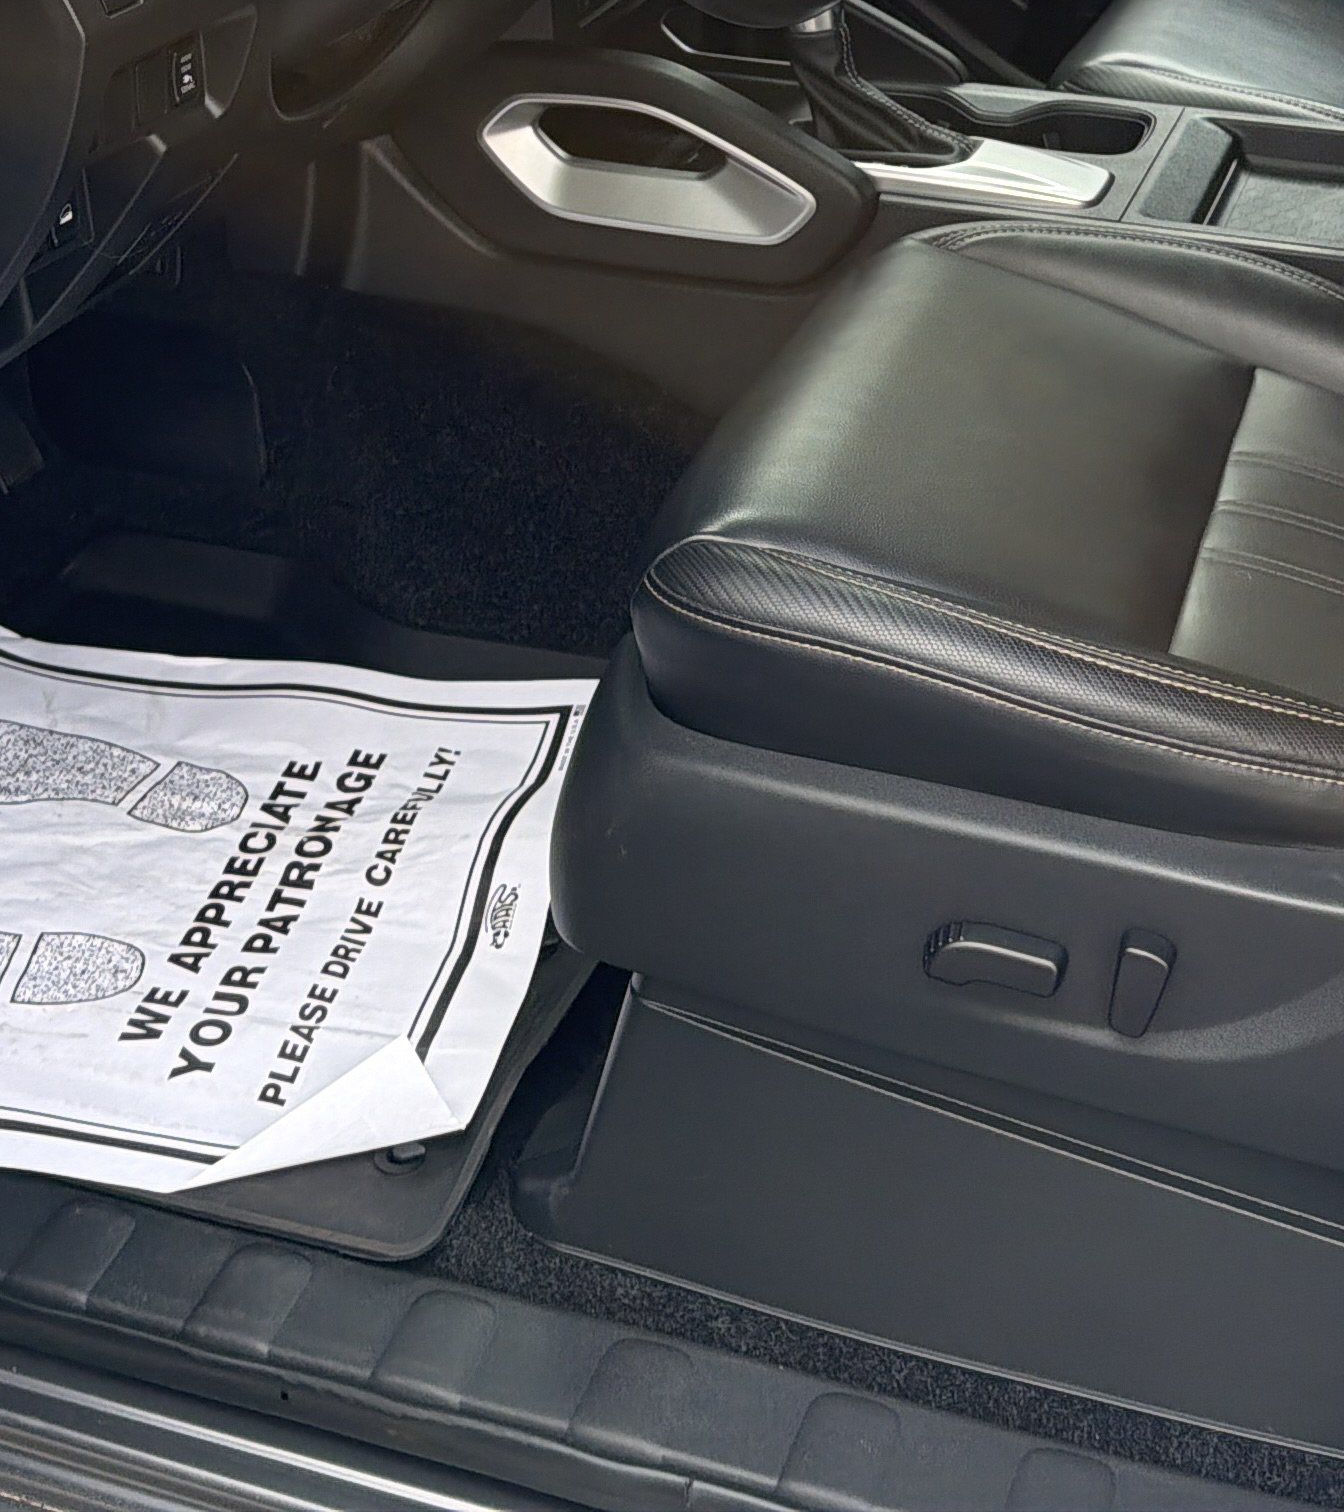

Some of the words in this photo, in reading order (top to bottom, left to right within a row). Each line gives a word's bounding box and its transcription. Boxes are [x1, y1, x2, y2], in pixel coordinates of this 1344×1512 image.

[118, 987, 190, 1041] WE
[167, 760, 323, 974] APPRECIATE
[168, 965, 269, 1081] YOUR
[241, 748, 388, 954] PATRONAGE
[257, 983, 339, 1107] PLEASE
[320, 896, 384, 980] DRIVE
[365, 746, 462, 887] CAREFULLY!
